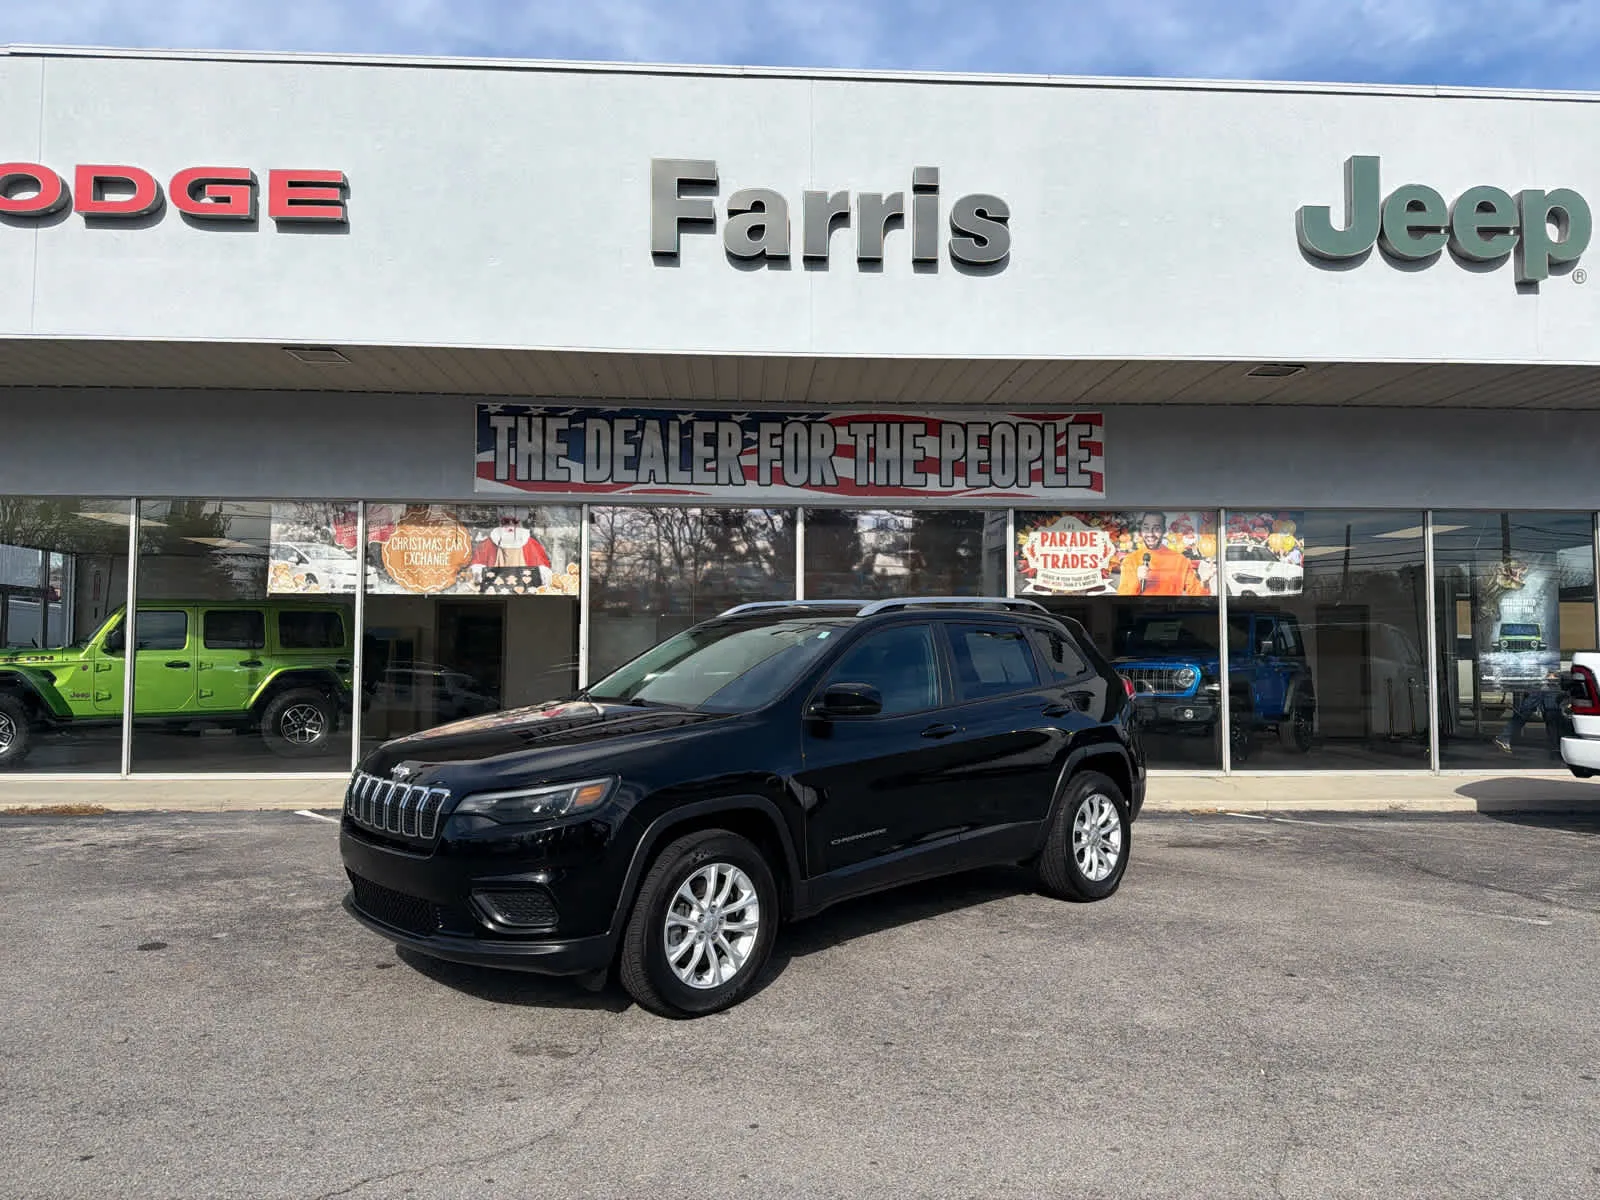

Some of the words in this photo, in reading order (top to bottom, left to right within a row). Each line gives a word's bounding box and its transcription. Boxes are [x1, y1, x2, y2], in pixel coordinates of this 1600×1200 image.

[650, 158, 1011, 265] Farris
[1296, 155, 1592, 283] Jeep
[489, 414, 571, 482] THE
[583, 417, 747, 486] DEALER
[757, 419, 839, 487] FOR
[848, 421, 928, 488] THE
[939, 421, 1094, 489] PEOPLE
[391, 536, 441, 552] CHRISTMAS
[445, 537, 463, 552] CAR
[1040, 531, 1098, 547] PARADE
[404, 552, 449, 566] EXCHANGE
[1040, 553, 1099, 569] TRADES
